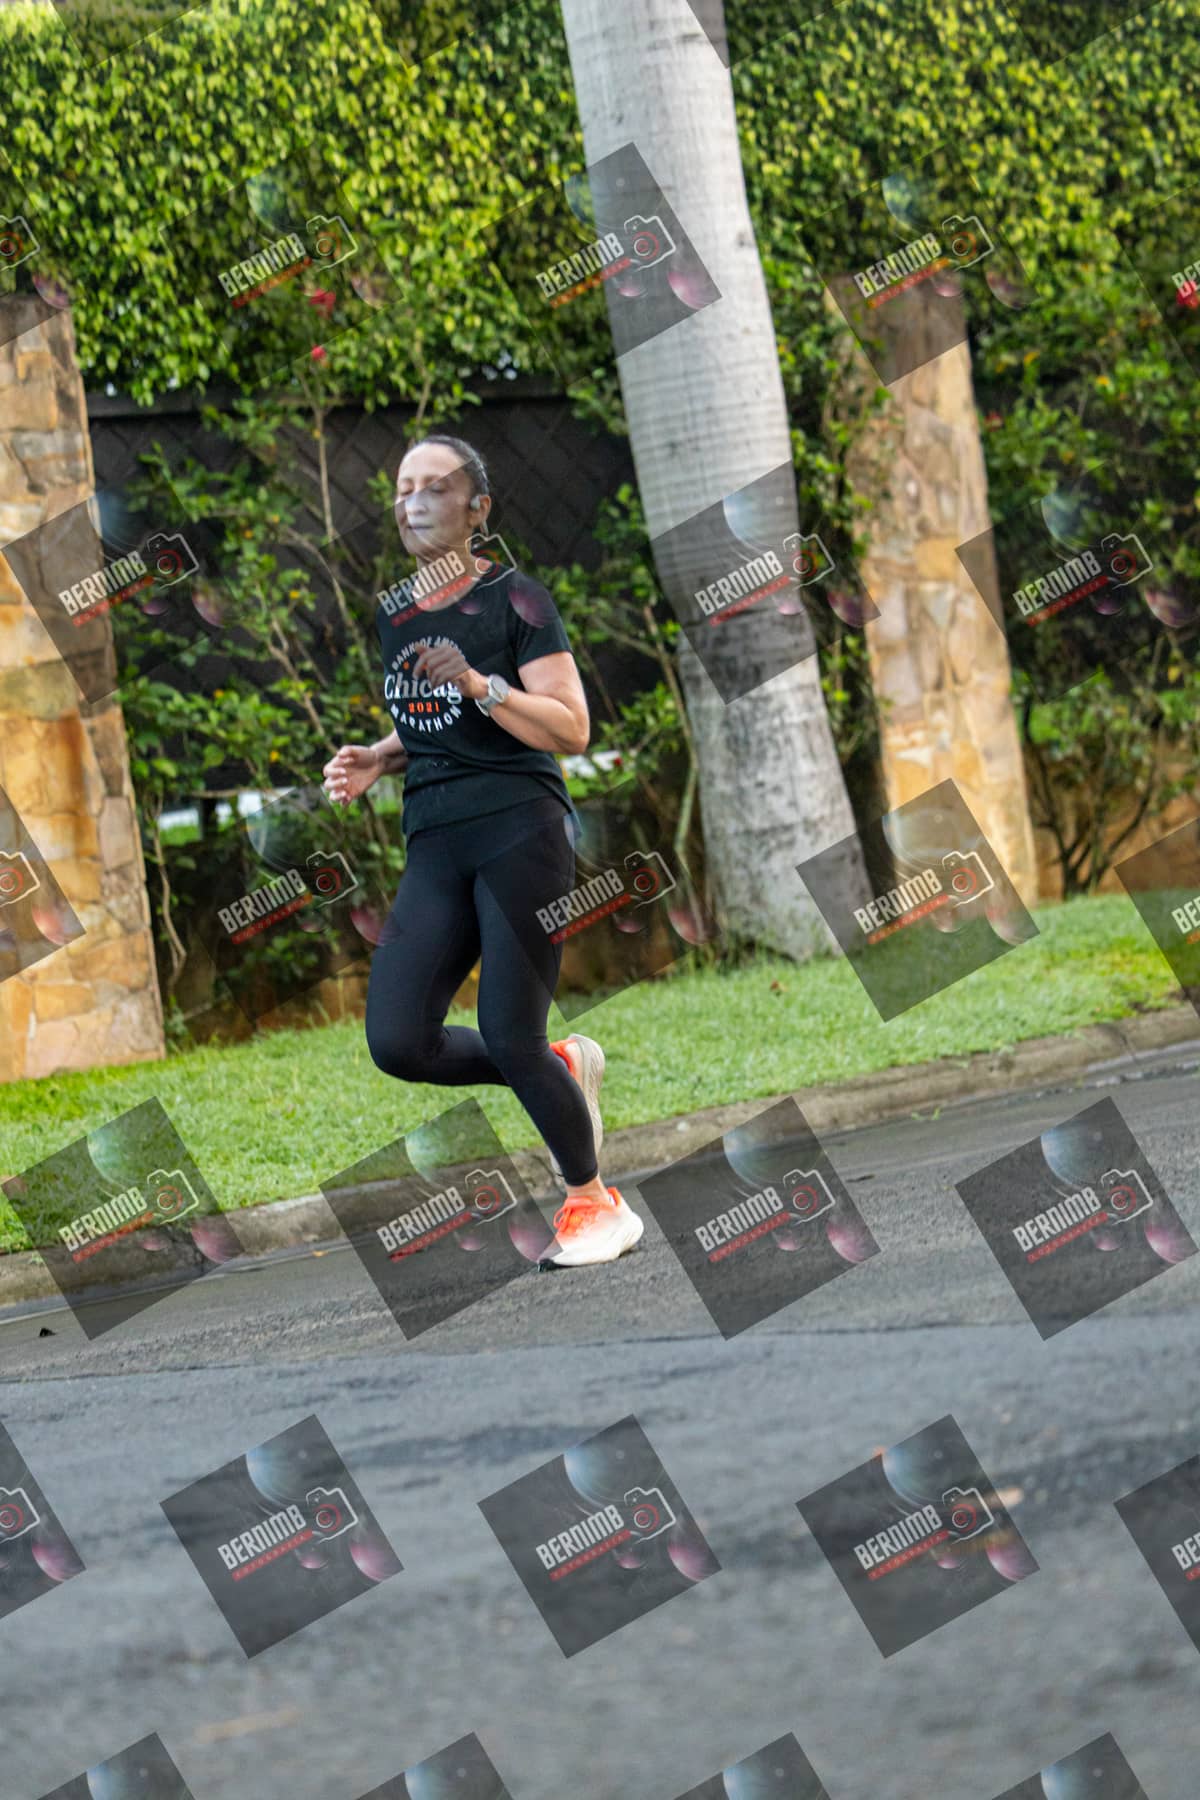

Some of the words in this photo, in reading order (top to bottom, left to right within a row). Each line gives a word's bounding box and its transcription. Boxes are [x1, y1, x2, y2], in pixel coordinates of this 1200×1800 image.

[384, 671, 463, 704] Chicag
[390, 703, 462, 732] MARATHON
[408, 701, 440, 713] 2021
